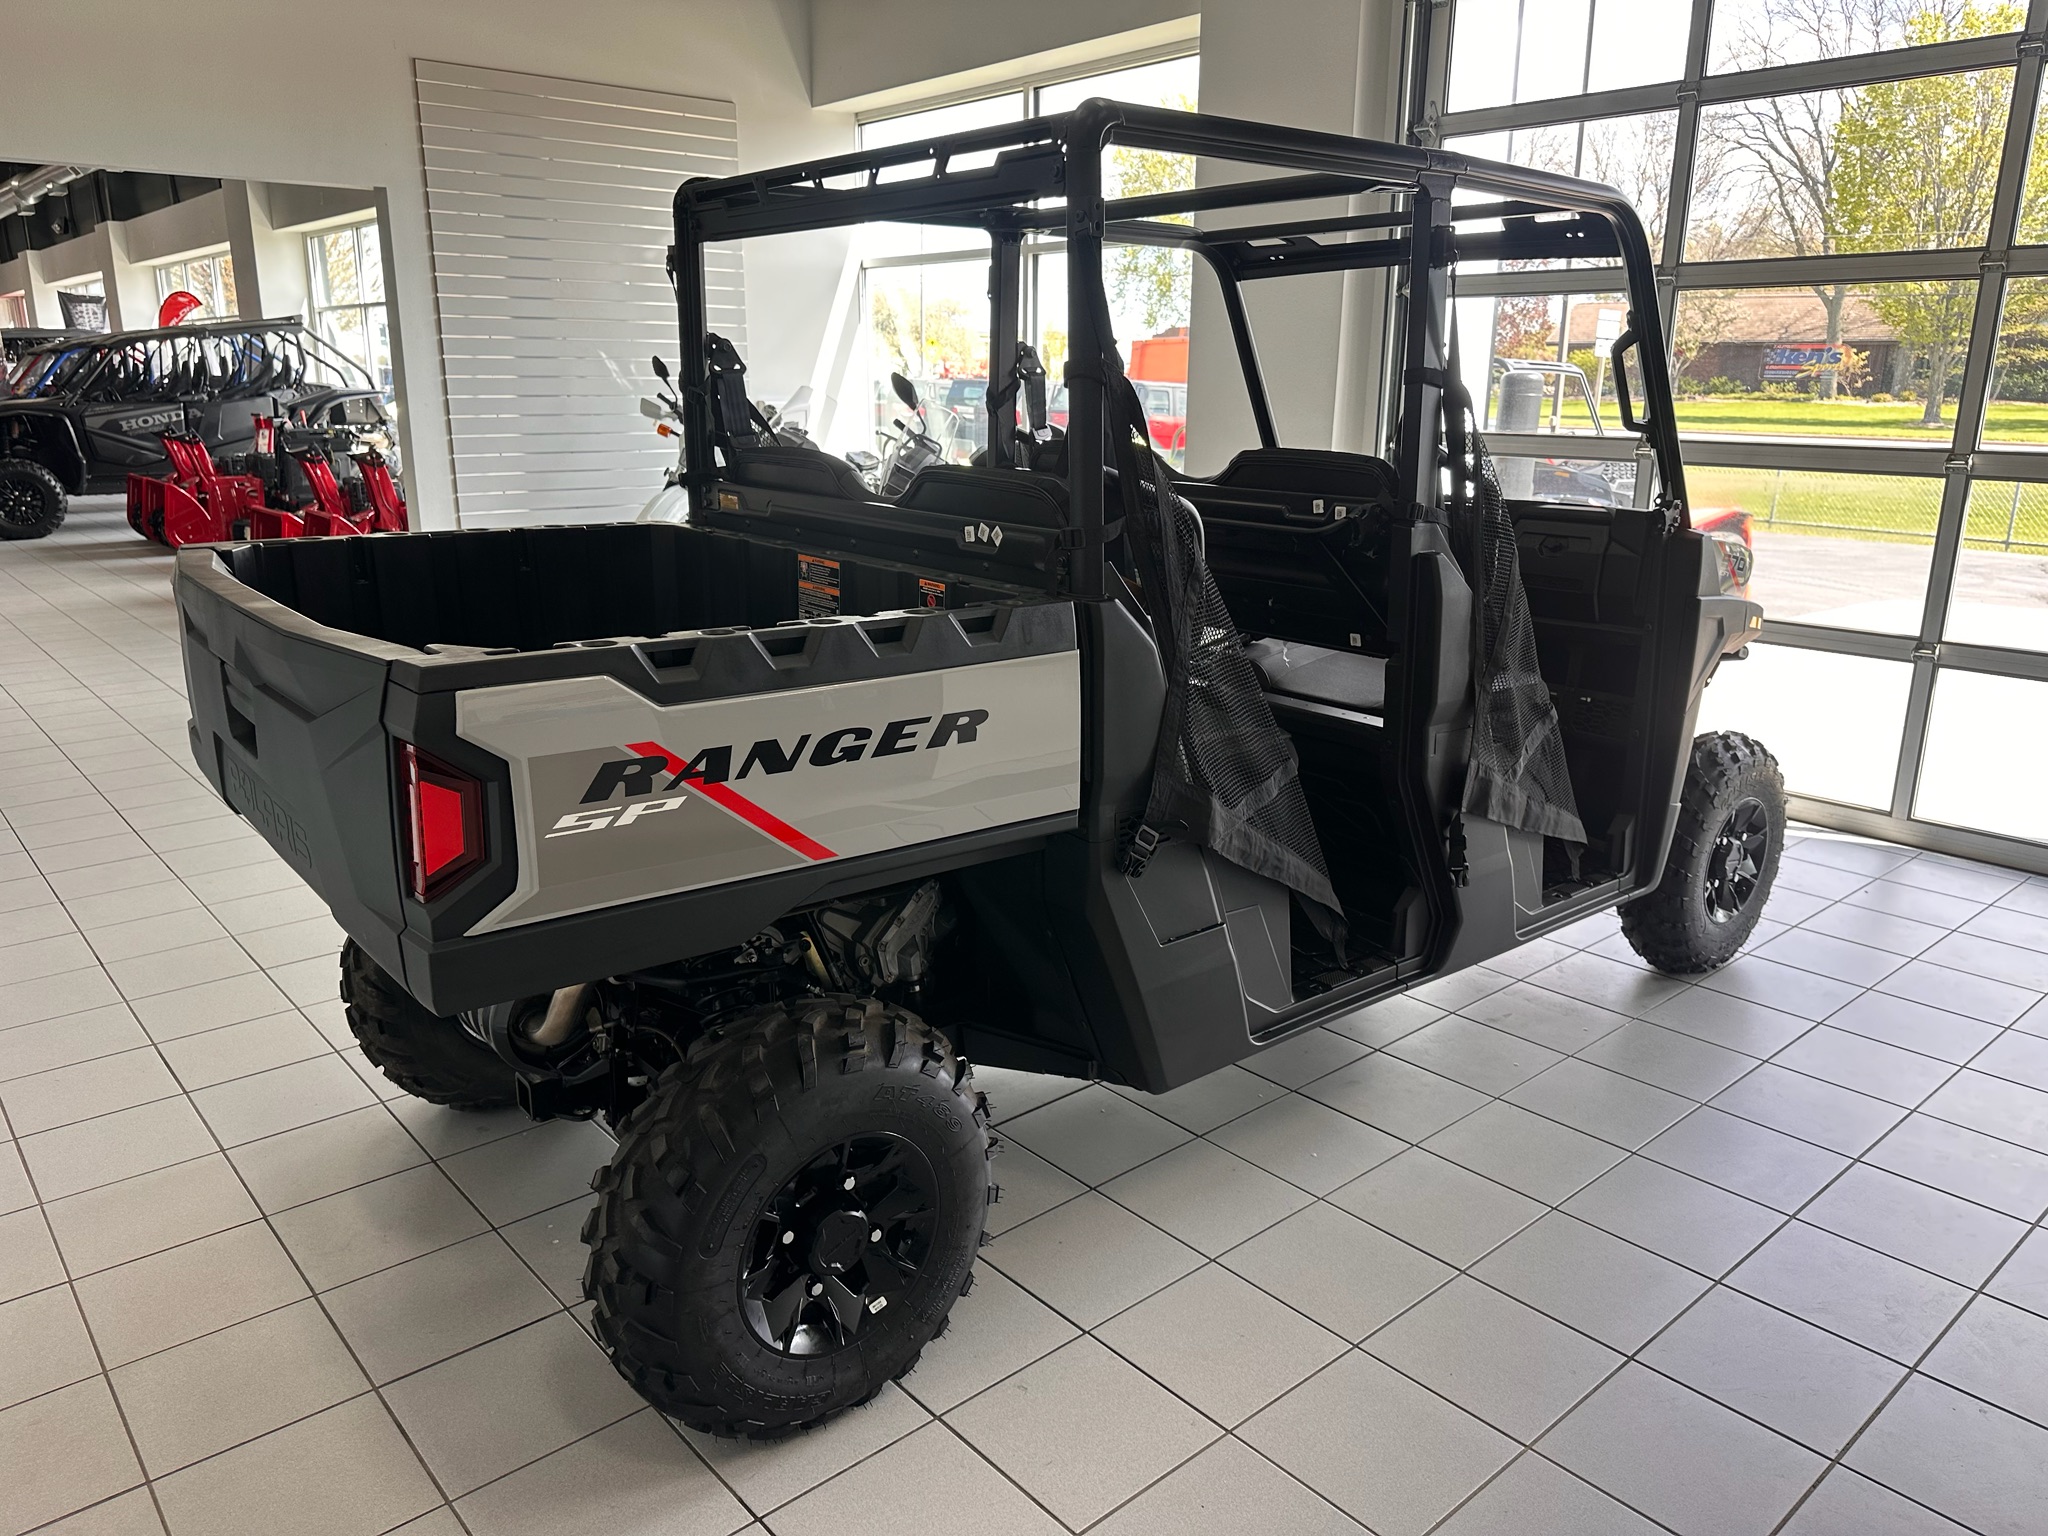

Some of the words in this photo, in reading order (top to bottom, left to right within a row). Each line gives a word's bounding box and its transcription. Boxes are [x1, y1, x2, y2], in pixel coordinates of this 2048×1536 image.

[119, 408, 202, 432] HONDA
[579, 709, 989, 805] RANGER
[226, 755, 312, 869] POLARIS
[544, 795, 688, 839] SP
[873, 1084, 963, 1133] AT489
